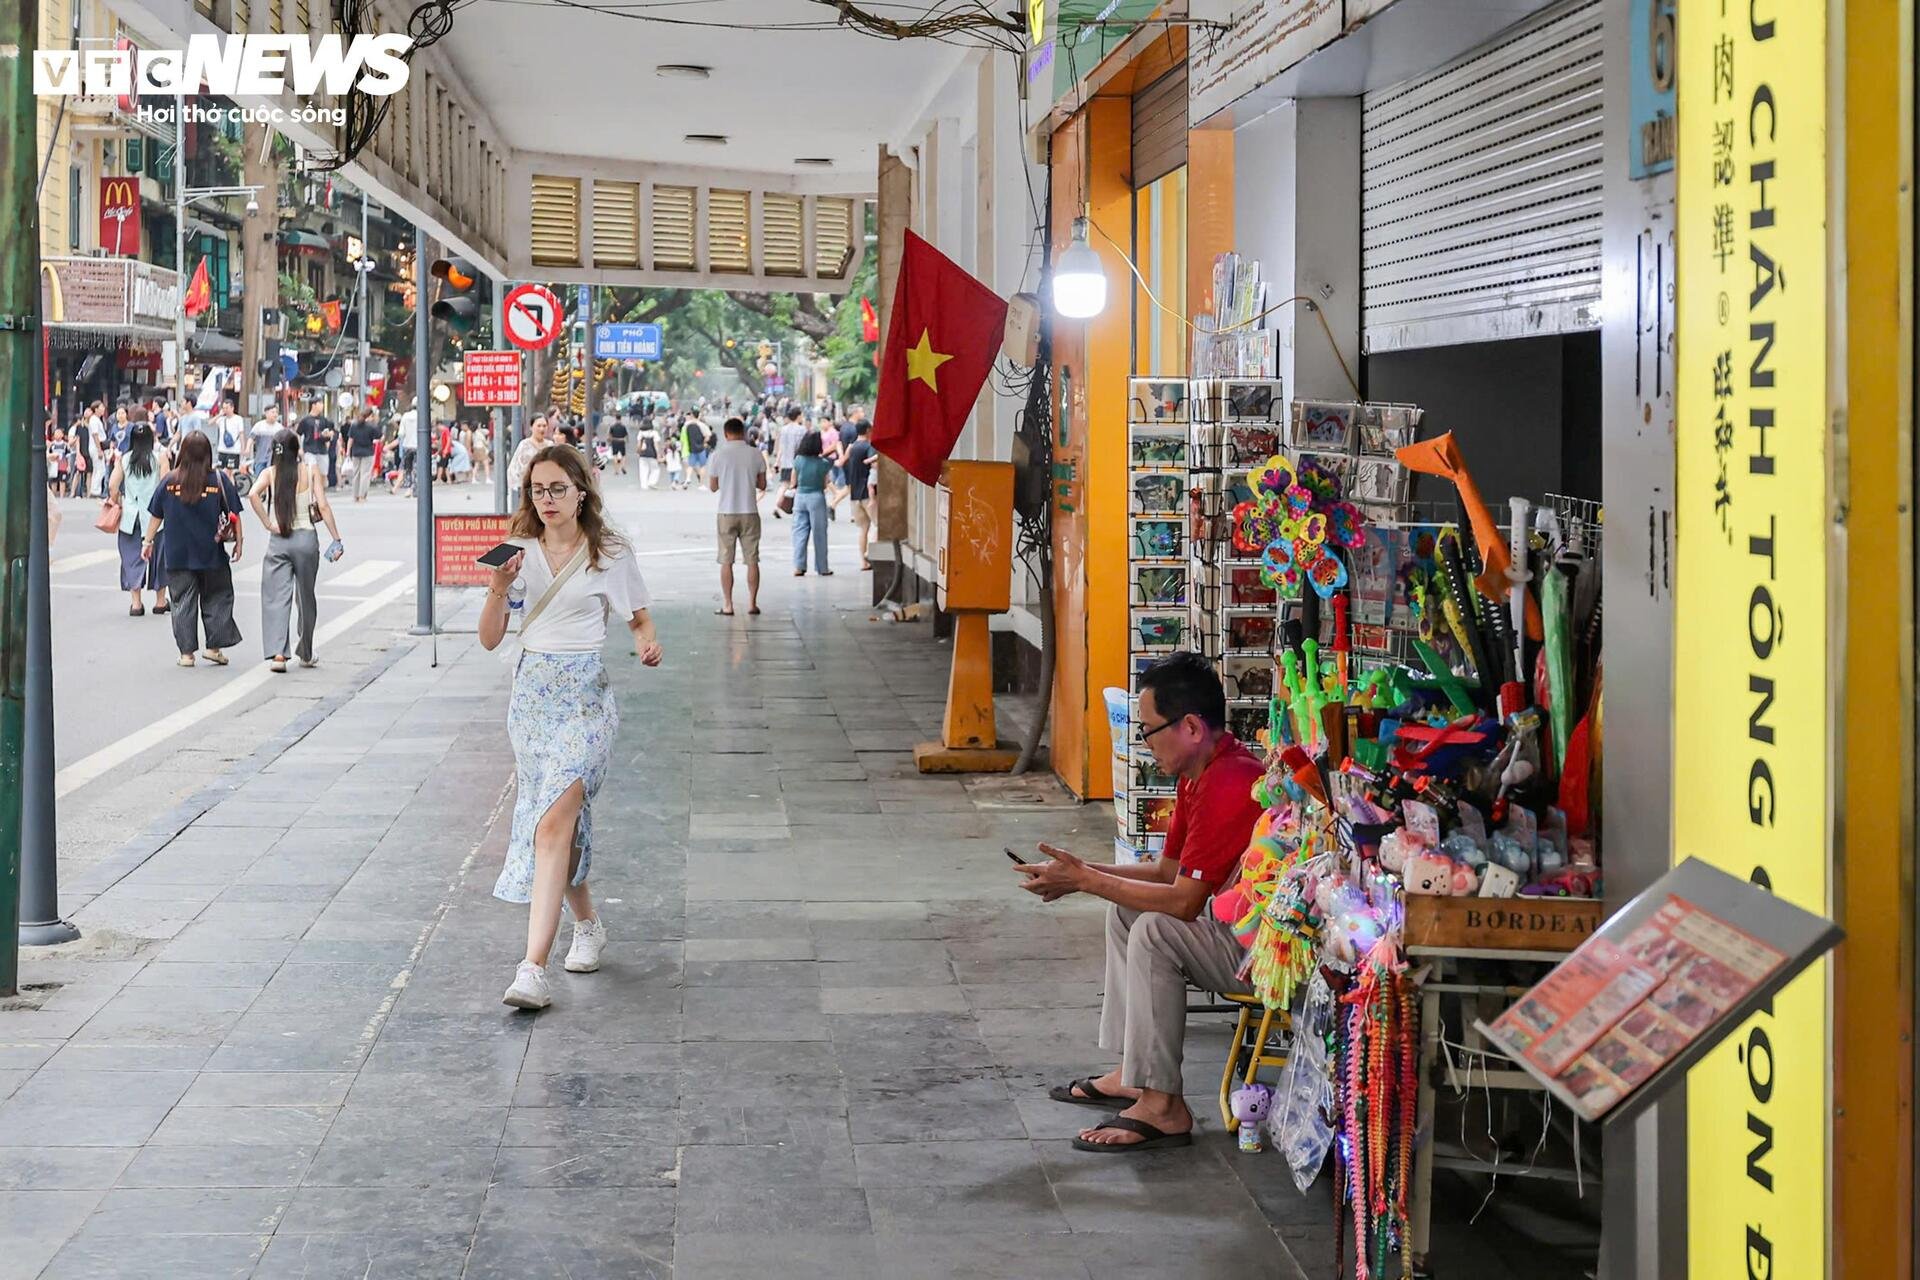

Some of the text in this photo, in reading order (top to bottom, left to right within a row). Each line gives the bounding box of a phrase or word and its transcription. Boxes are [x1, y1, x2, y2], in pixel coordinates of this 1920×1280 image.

[622, 326, 644, 337] PHỐ
[466, 517, 481, 531] PHỐ
[1748, 514, 1784, 828] TÔNG
[1738, 865, 1774, 1194] ỌN
